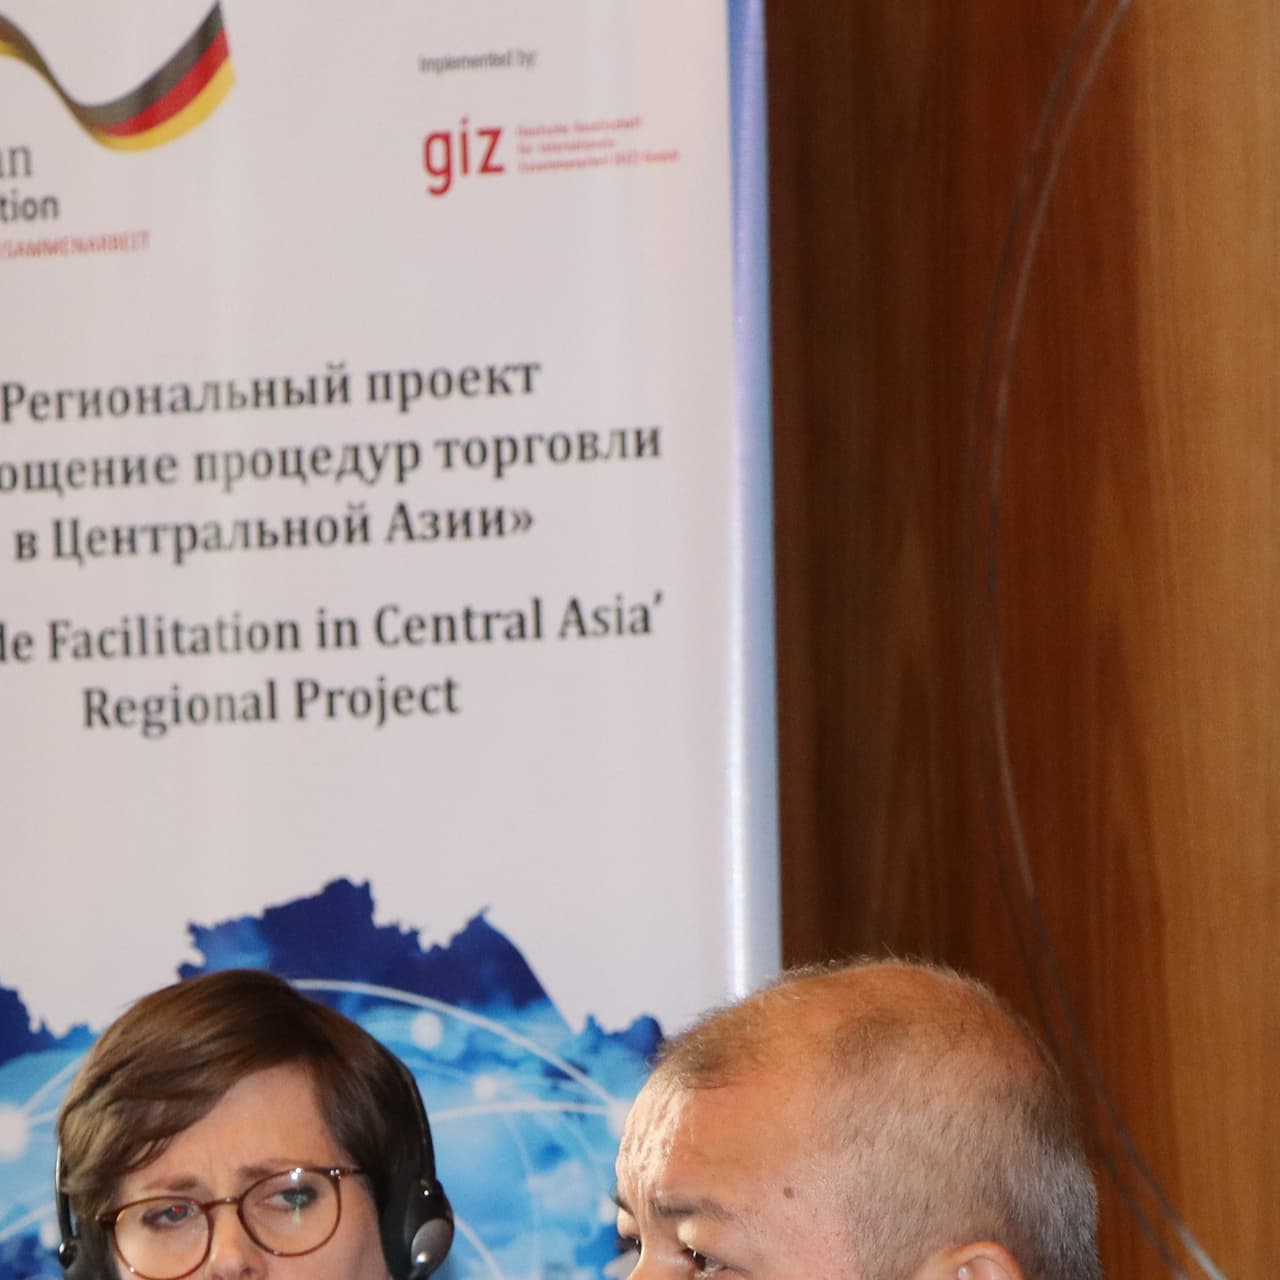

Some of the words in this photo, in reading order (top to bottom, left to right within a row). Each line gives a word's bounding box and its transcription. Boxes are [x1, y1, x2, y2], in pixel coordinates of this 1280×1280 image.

[423, 115, 505, 197] giz
[0, 361, 352, 424] Региональный
[366, 361, 542, 414] проект
[192, 437, 422, 493] процедур
[433, 424, 662, 480] торговли
[13, 527, 39, 563] в
[51, 500, 372, 568] Центральной
[385, 500, 535, 544] Азии»
[47, 610, 301, 663] Facilitation
[316, 606, 360, 650] in
[374, 595, 544, 648] Central
[82, 678, 277, 740] Regional
[293, 674, 461, 729] Project
